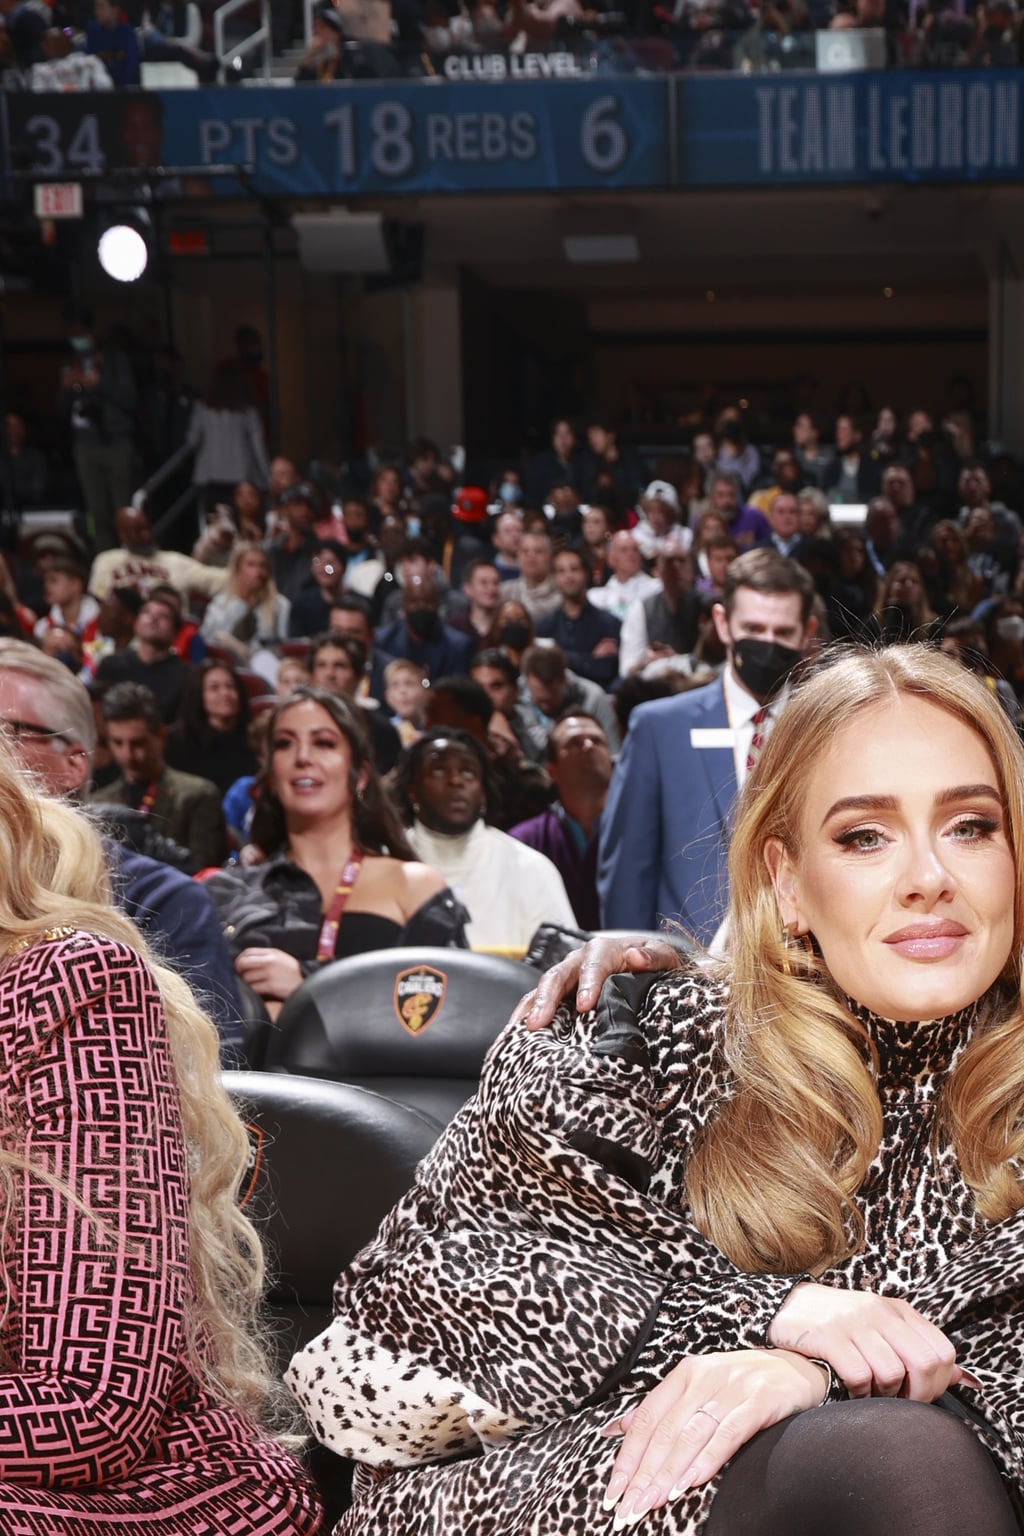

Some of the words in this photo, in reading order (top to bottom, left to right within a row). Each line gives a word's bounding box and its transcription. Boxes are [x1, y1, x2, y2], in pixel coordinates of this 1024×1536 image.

[444, 54, 507, 81] CLUB
[510, 51, 581, 80] LEVEL
[25, 114, 106, 176] 34
[201, 117, 298, 166] PTS
[324, 102, 414, 178] 18
[427, 112, 537, 161] REBS
[581, 97, 627, 173] 6
[756, 86, 857, 173] TEAM
[869, 82, 1020, 171] LeBRON
[41, 183, 77, 216] EXIT
